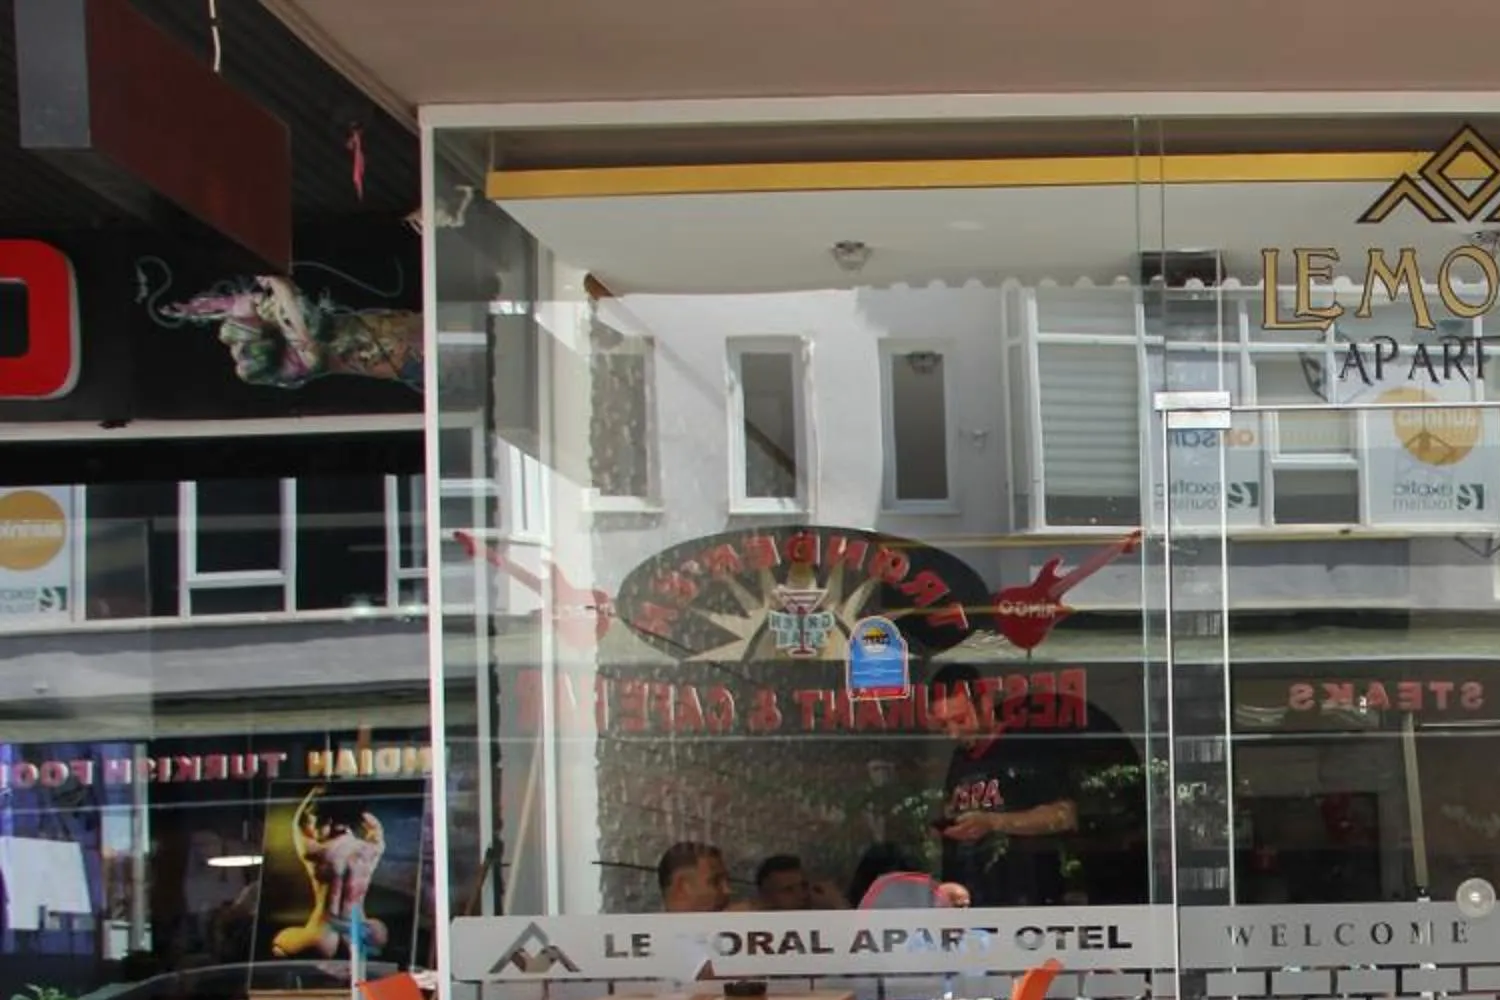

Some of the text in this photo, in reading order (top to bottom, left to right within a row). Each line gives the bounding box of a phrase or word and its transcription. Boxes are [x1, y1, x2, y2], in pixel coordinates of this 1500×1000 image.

[603, 932, 653, 958] LE
[676, 930, 835, 957] ORAL
[1013, 924, 1134, 951] OTEL
[1226, 919, 1470, 949] WELCOME
